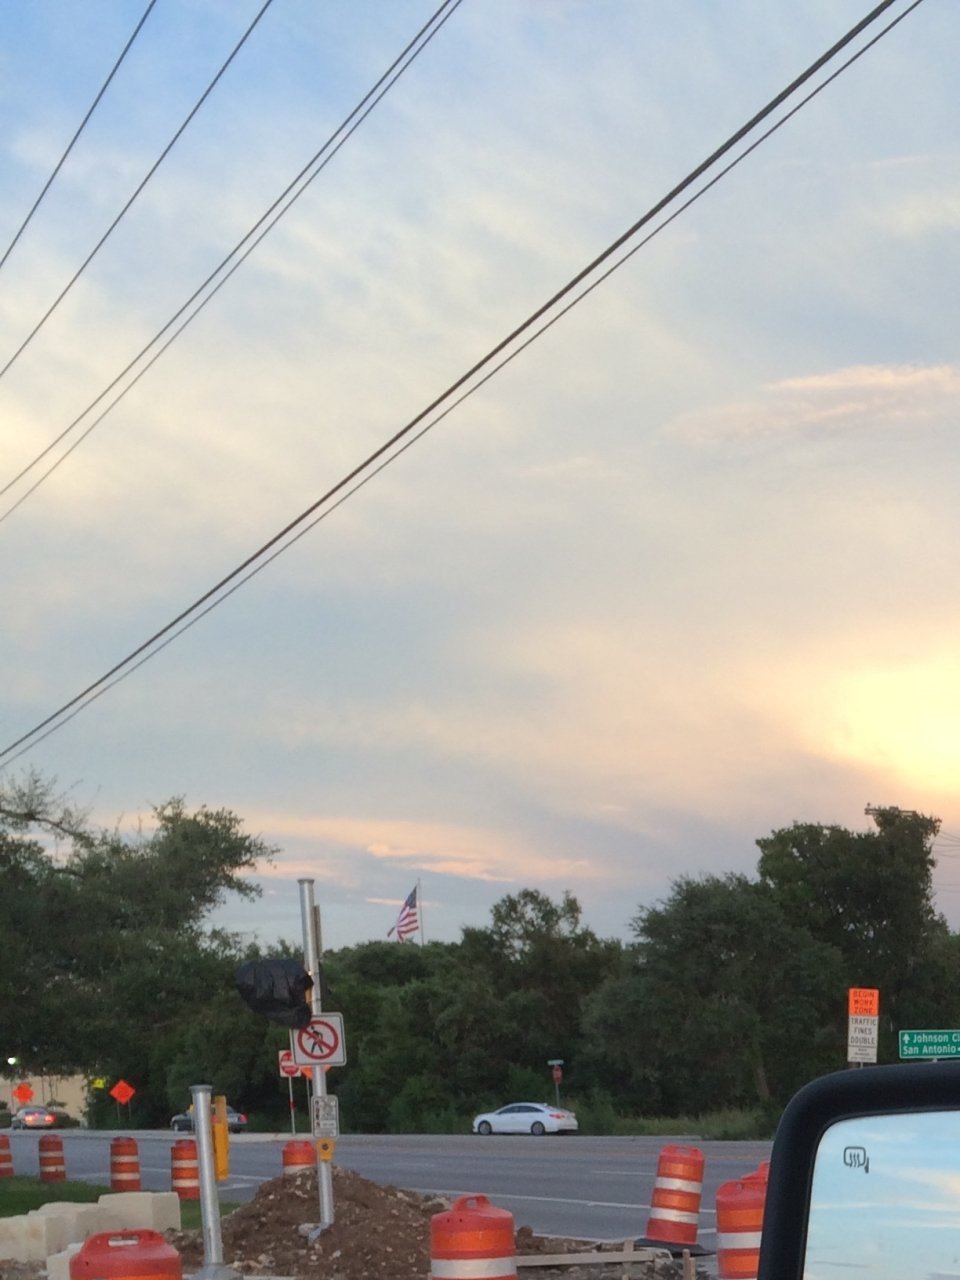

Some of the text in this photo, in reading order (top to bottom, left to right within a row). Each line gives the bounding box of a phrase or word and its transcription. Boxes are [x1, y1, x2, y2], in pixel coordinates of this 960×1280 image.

[853, 999, 873, 1007] WORK
[851, 1017, 877, 1026] TRAFFIC
[854, 1026, 873, 1035] FINES
[850, 1036, 876, 1045] DOUBLE
[913, 1033, 949, 1043] Johnson
[903, 1044, 957, 1055] San Antonio
